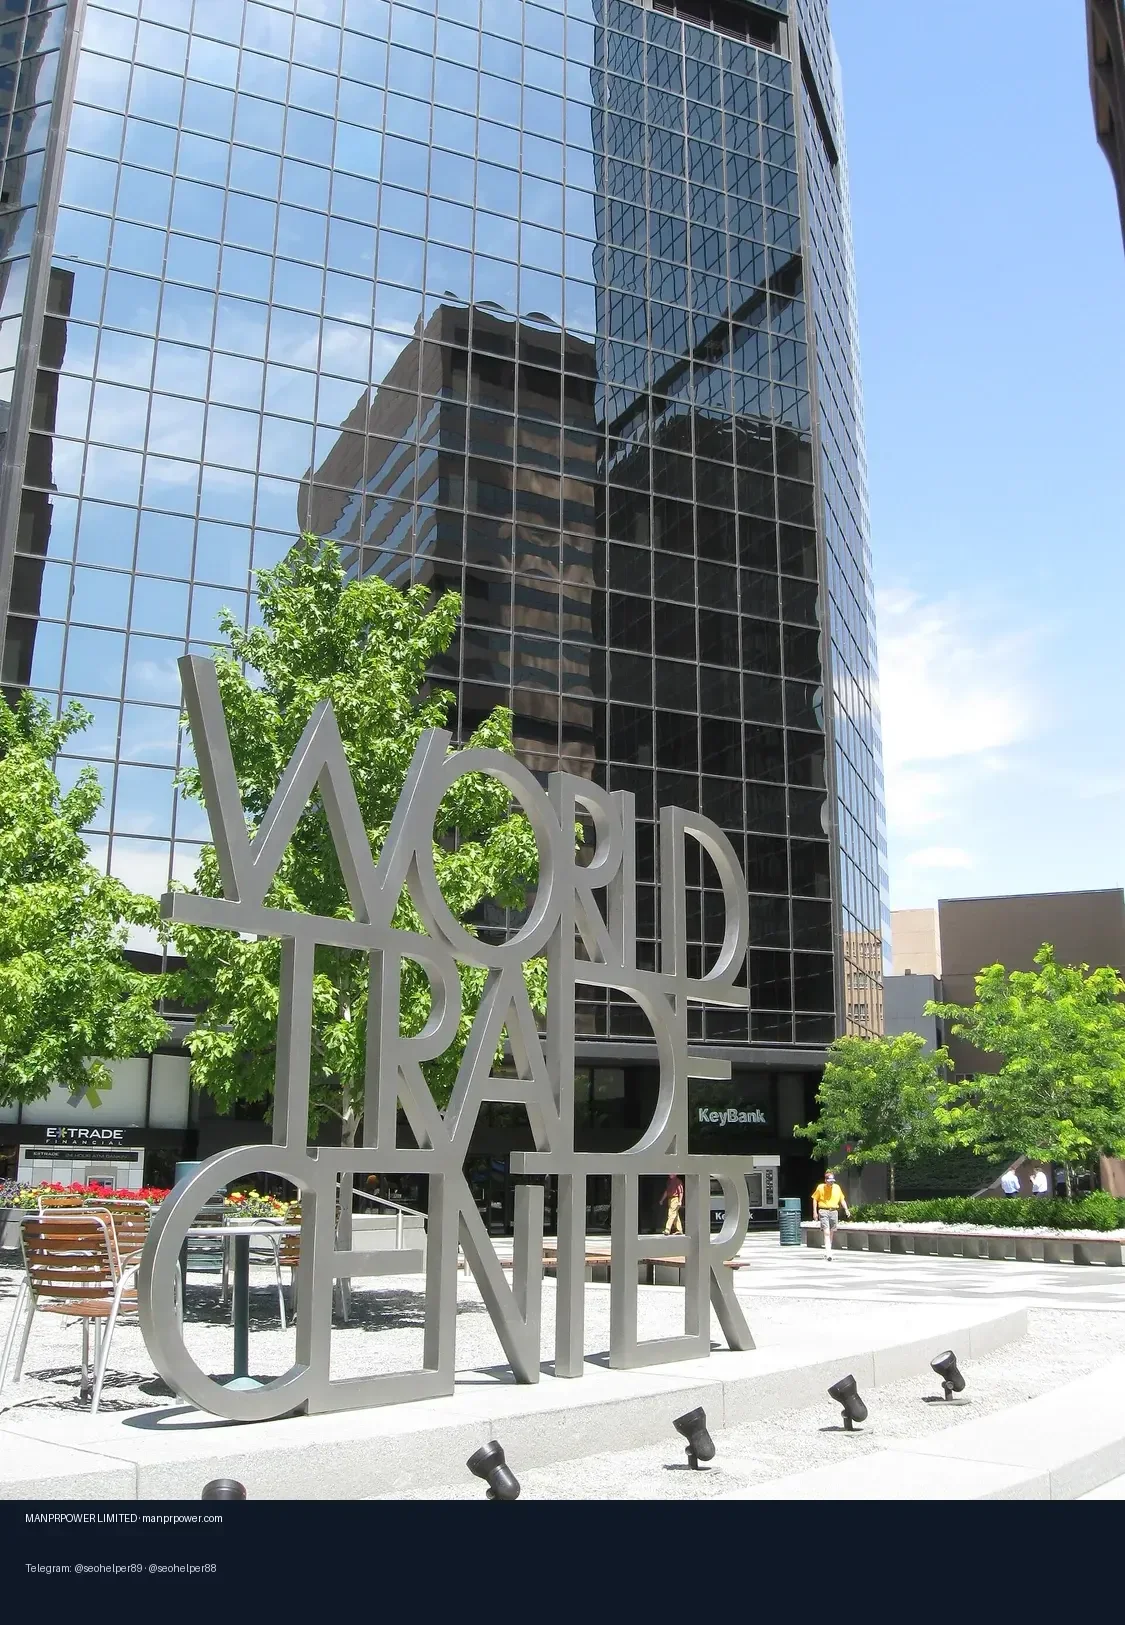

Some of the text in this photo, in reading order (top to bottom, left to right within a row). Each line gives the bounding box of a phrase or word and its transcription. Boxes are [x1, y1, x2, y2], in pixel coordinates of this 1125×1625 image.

[178, 654, 749, 988] WORLD
[161, 890, 752, 1174] TRADE
[698, 1107, 766, 1127] KeyBank
[139, 1145, 756, 1421] CENTER
